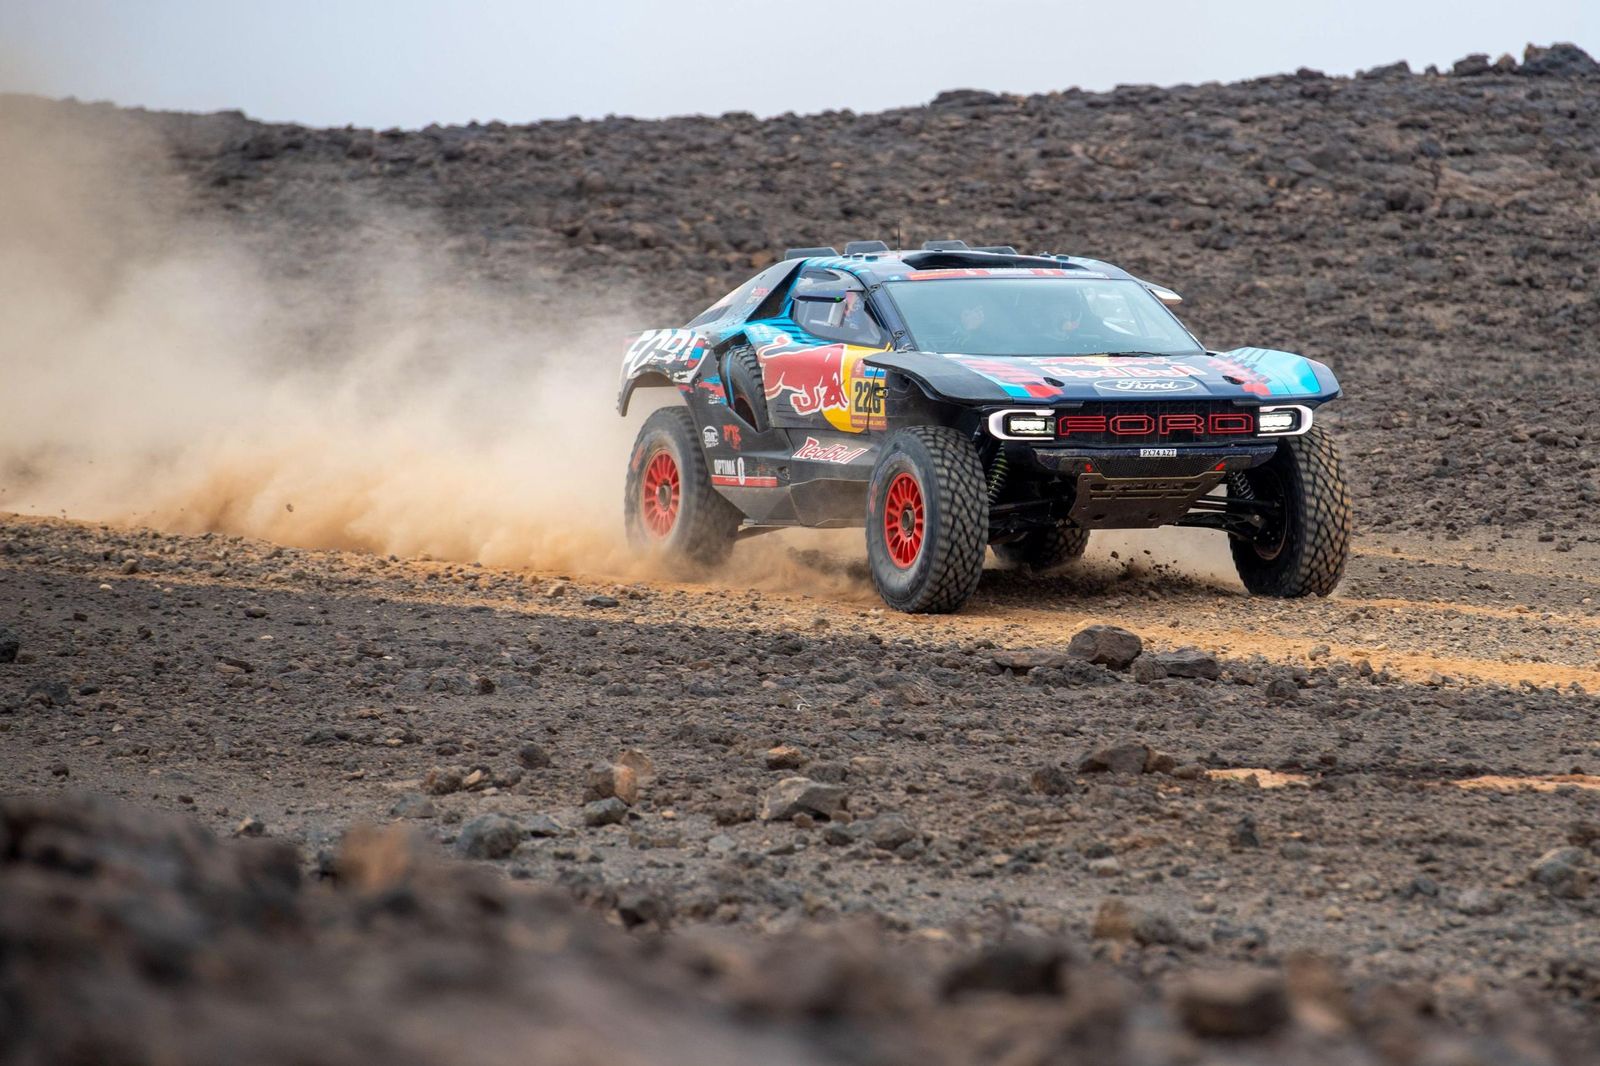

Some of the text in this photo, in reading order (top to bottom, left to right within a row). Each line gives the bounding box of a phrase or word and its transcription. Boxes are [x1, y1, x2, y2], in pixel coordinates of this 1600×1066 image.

[1115, 379, 1179, 390] Ford
[1058, 412, 1254, 436] FORD
[1142, 449, 1176, 457] PX74 AZT
